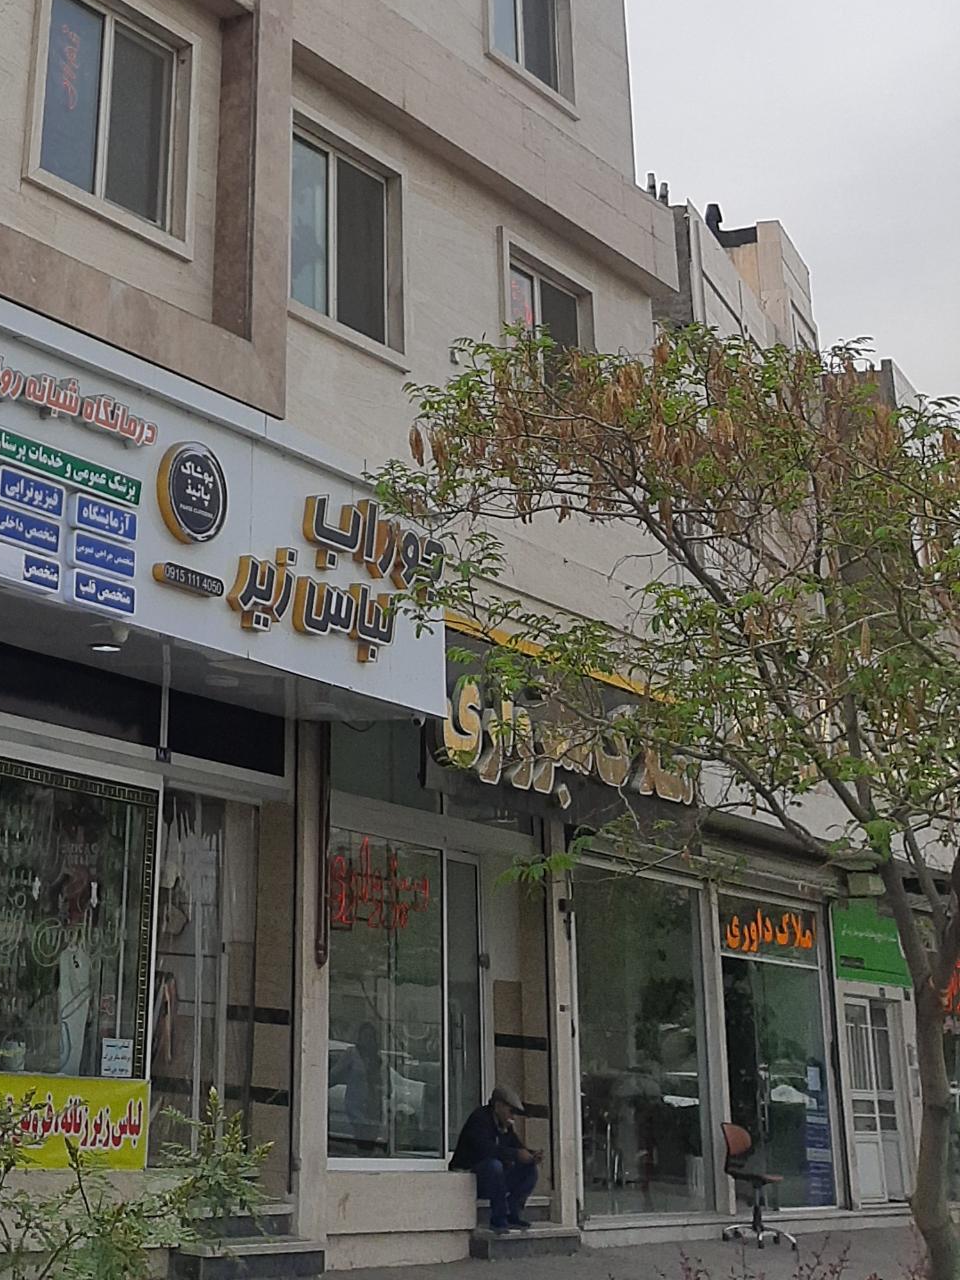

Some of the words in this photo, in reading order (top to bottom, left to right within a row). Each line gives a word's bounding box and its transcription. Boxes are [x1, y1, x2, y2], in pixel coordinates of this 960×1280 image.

[25, 375, 80, 418] شبانه
[82, 394, 159, 447] درمانگاه
[28, 448, 64, 468] خدمات
[65, 463, 72, 478] و
[73, 467, 107, 487] عمومی
[108, 477, 137, 502] پزشک
[180, 461, 214, 489] پوشاک
[82, 502, 132, 534] آزمایشگاه
[24, 527, 58, 544] متخصص
[23, 565, 59, 582] متخصص
[78, 580, 97, 596] قلب
[164, 564, 185, 583] 0915
[187, 572, 201, 589] 111
[201, 576, 223, 595] 4050
[96, 587, 132, 605] متخصص
[234, 547, 297, 633] زیر
[298, 577, 398, 663] لباس
[726, 908, 773, 954] داوری
[775, 910, 817, 950] املاک
[89, 1106, 110, 1148] زیر
[111, 1098, 143, 1149] لباس
